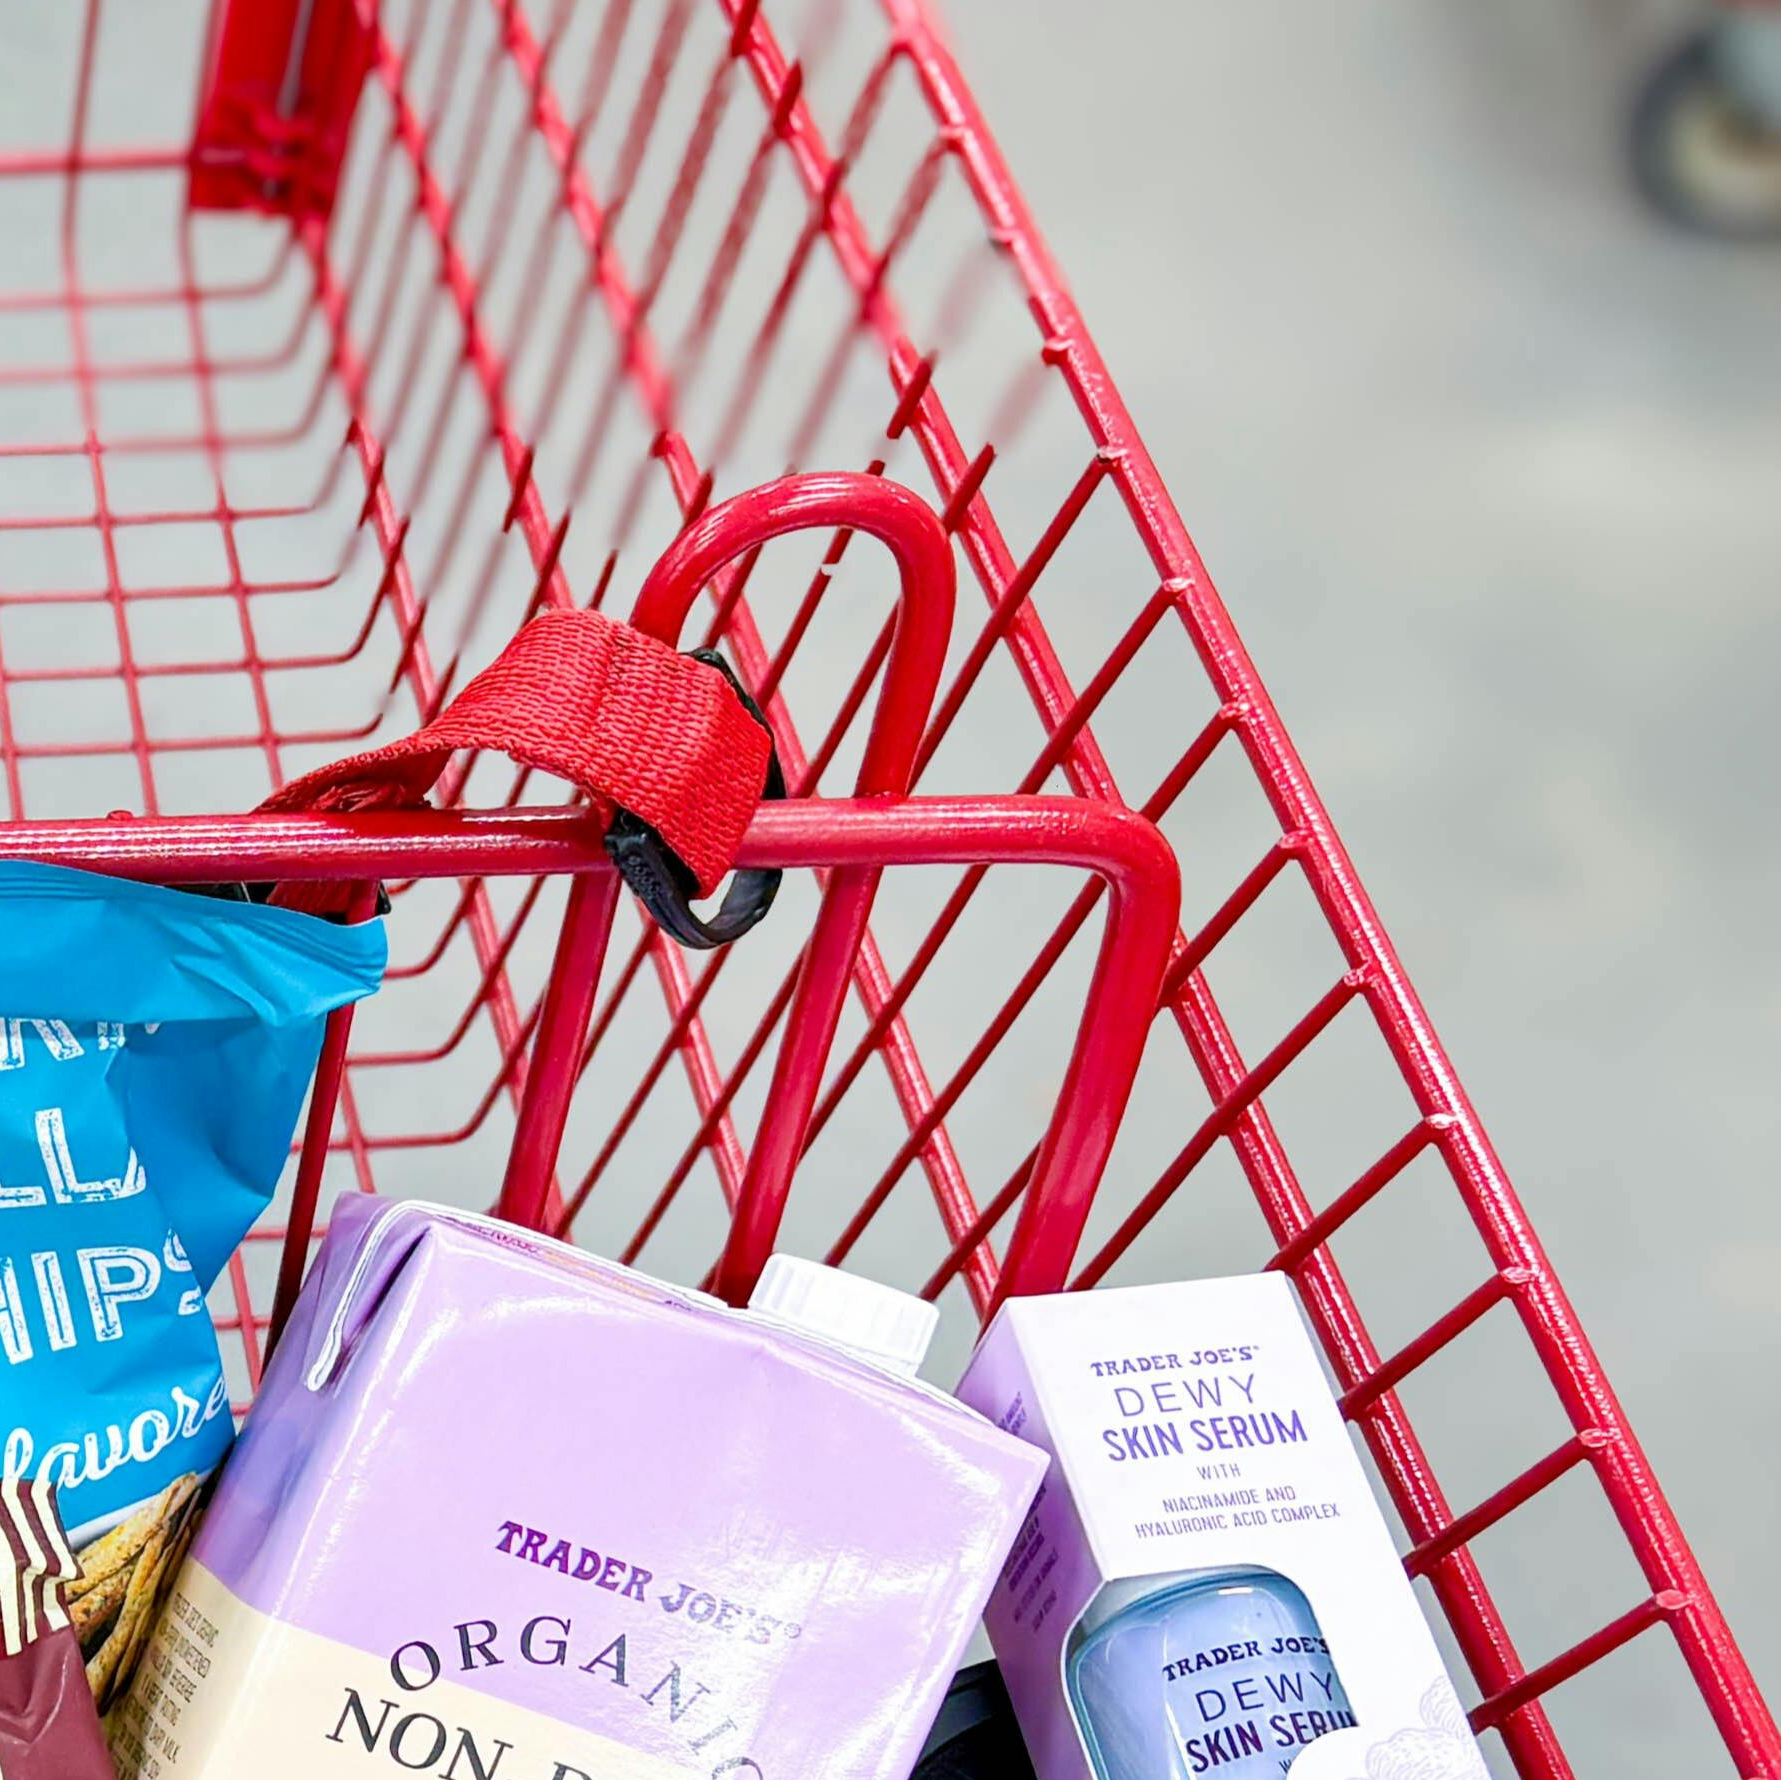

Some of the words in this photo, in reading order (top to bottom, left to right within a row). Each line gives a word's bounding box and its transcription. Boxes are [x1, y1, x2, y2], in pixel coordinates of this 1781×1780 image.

[1090, 1353, 1184, 1378] TRADER
[1113, 1372, 1255, 1418] DEWY
[1102, 1421, 1185, 1462] SKIN
[1189, 1409, 1309, 1452] SERUM
[1196, 1463, 1242, 1481] WITH
[1134, 1513, 1229, 1540] HYALURONIC
[1233, 1509, 1269, 1529] ACID
[1270, 1502, 1341, 1526] COMPLEX
[1162, 1488, 1260, 1514] NIACINAMIDE
[1265, 1485, 1297, 1503] AND
[494, 1519, 654, 1603] TRADER
[1162, 1640, 1263, 1682] TRADER
[1194, 1670, 1334, 1723] DEWY
[1185, 1719, 1265, 1774] SKIN
[1269, 1710, 1359, 1748] SERU
